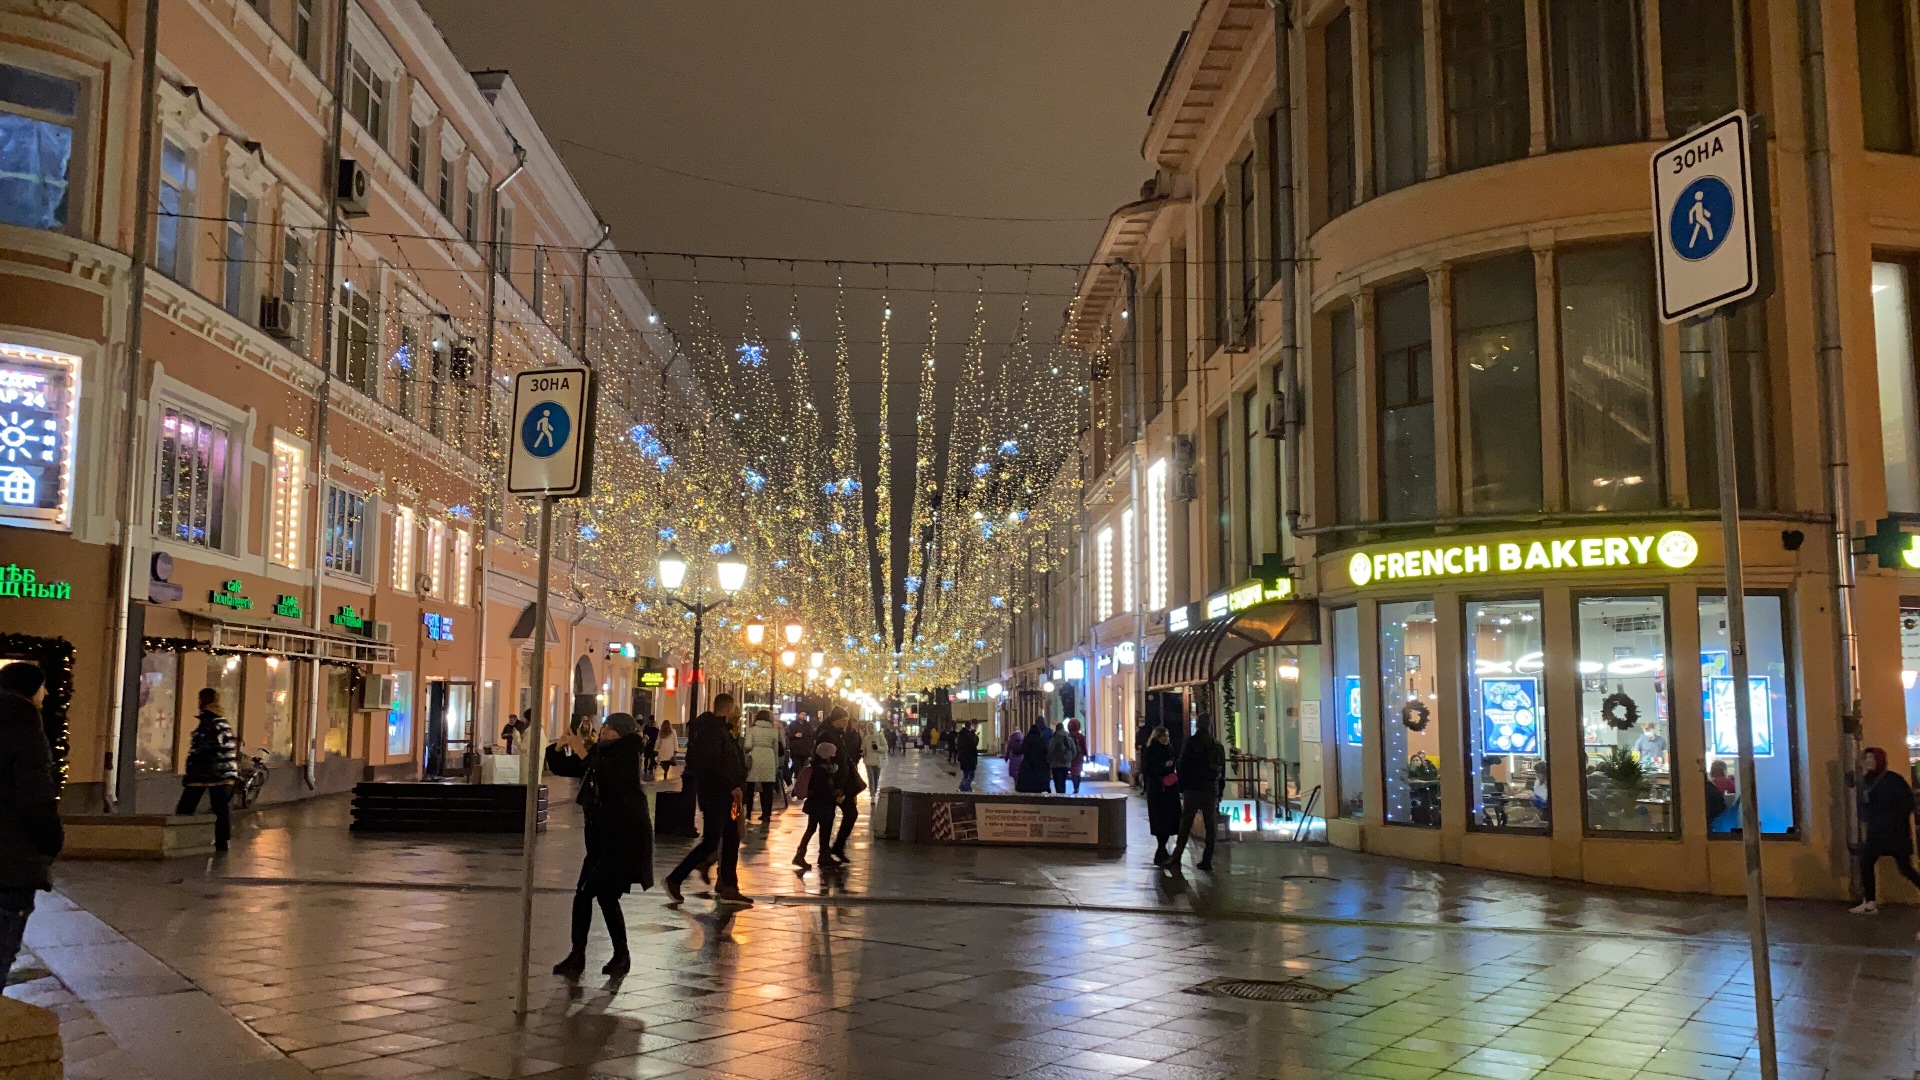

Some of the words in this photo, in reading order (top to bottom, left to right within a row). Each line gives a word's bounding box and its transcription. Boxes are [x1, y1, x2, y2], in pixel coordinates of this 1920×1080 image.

[1672, 136, 1724, 174] ЗОНА
[530, 377, 570, 392] ЗОНА
[1373, 545, 1488, 579] FRENCH
[1499, 536, 1656, 570] BAKERY
[985, 814, 1037, 822] МОСКОВСКИЕ
